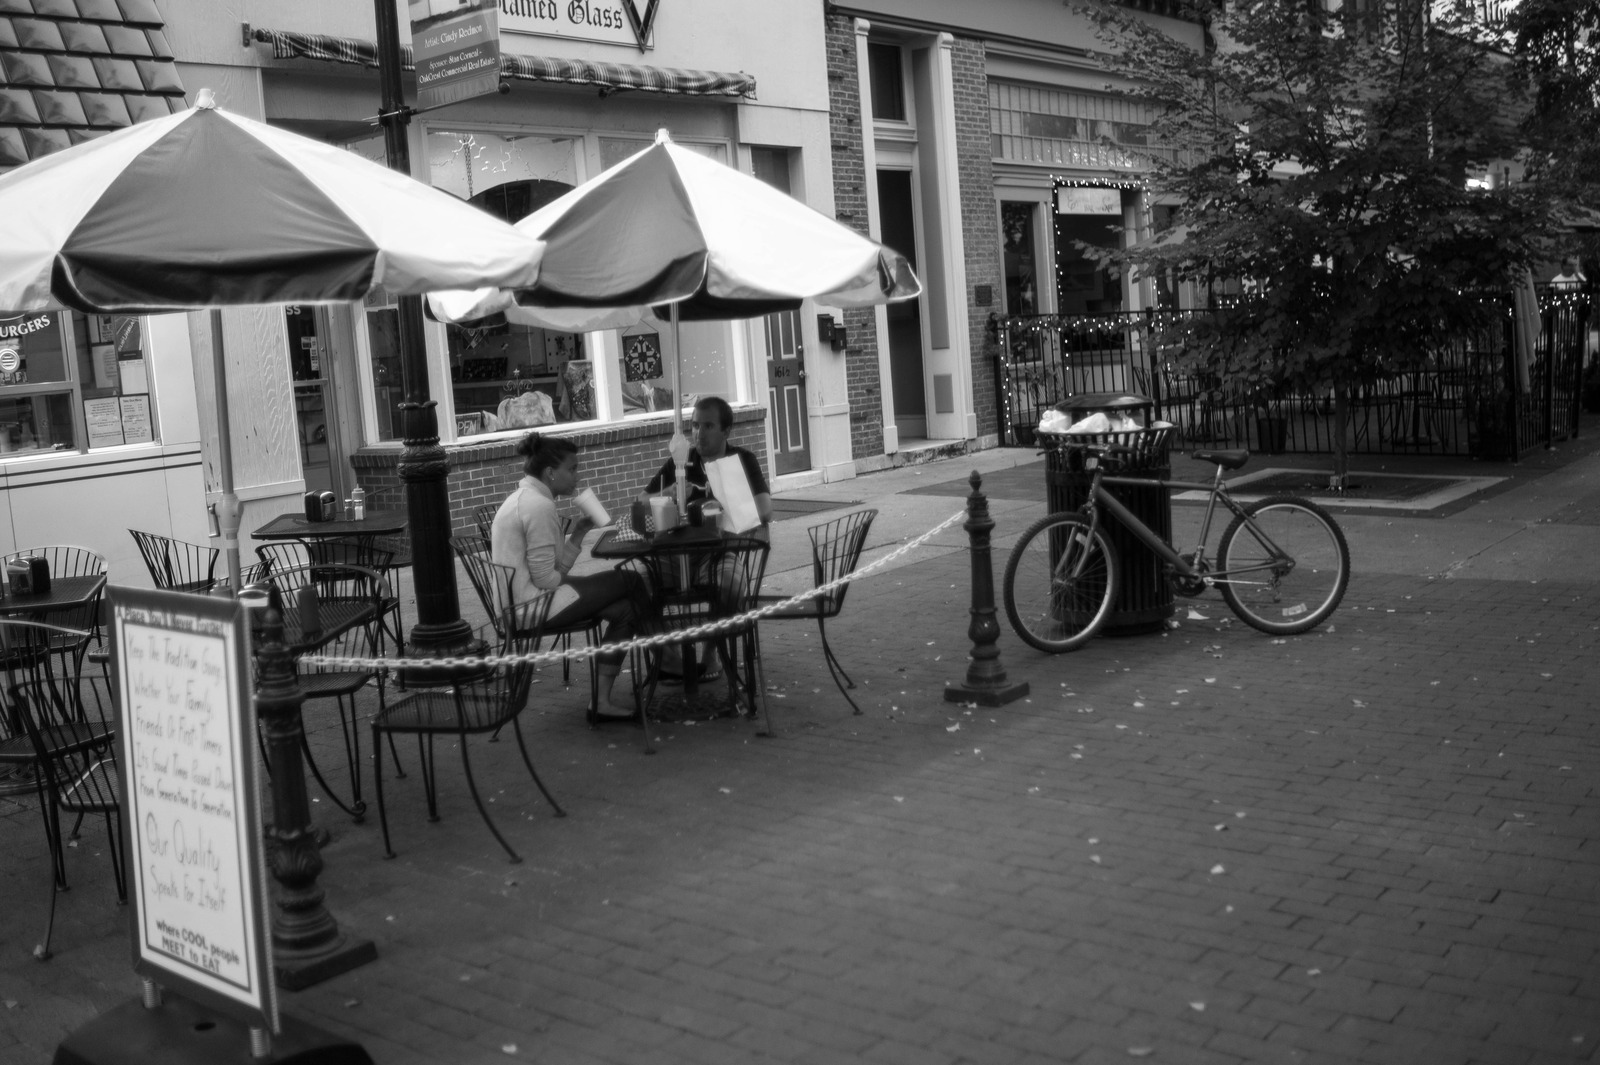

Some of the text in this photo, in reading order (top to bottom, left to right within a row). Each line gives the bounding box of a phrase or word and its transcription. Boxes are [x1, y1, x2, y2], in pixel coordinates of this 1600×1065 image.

[500, 0, 623, 30] tained Glass
[440, 30, 458, 43] Cindy
[458, 25, 483, 38] Redmon
[418, 57, 496, 84] OakCrest Commercial Real Estate
[171, 613, 195, 632] Never
[128, 631, 144, 663] Keep
[148, 635, 160, 661] The
[163, 637, 198, 671] Tradition
[132, 671, 161, 699] Whether
[166, 674, 180, 705] Your
[136, 705, 163, 737] Friends
[167, 715, 176, 739] Or
[152, 747, 169, 774] Good
[172, 752, 188, 780] Times
[192, 758, 212, 787] Passed
[140, 775, 155, 798] From
[156, 777, 189, 806] Generation
[191, 788, 198, 810] To
[145, 811, 220, 890] Our Quality
[150, 864, 226, 912] Speaks For Itself
[156, 919, 240, 965] where COOL people
[162, 936, 220, 973] MEET to EAT
